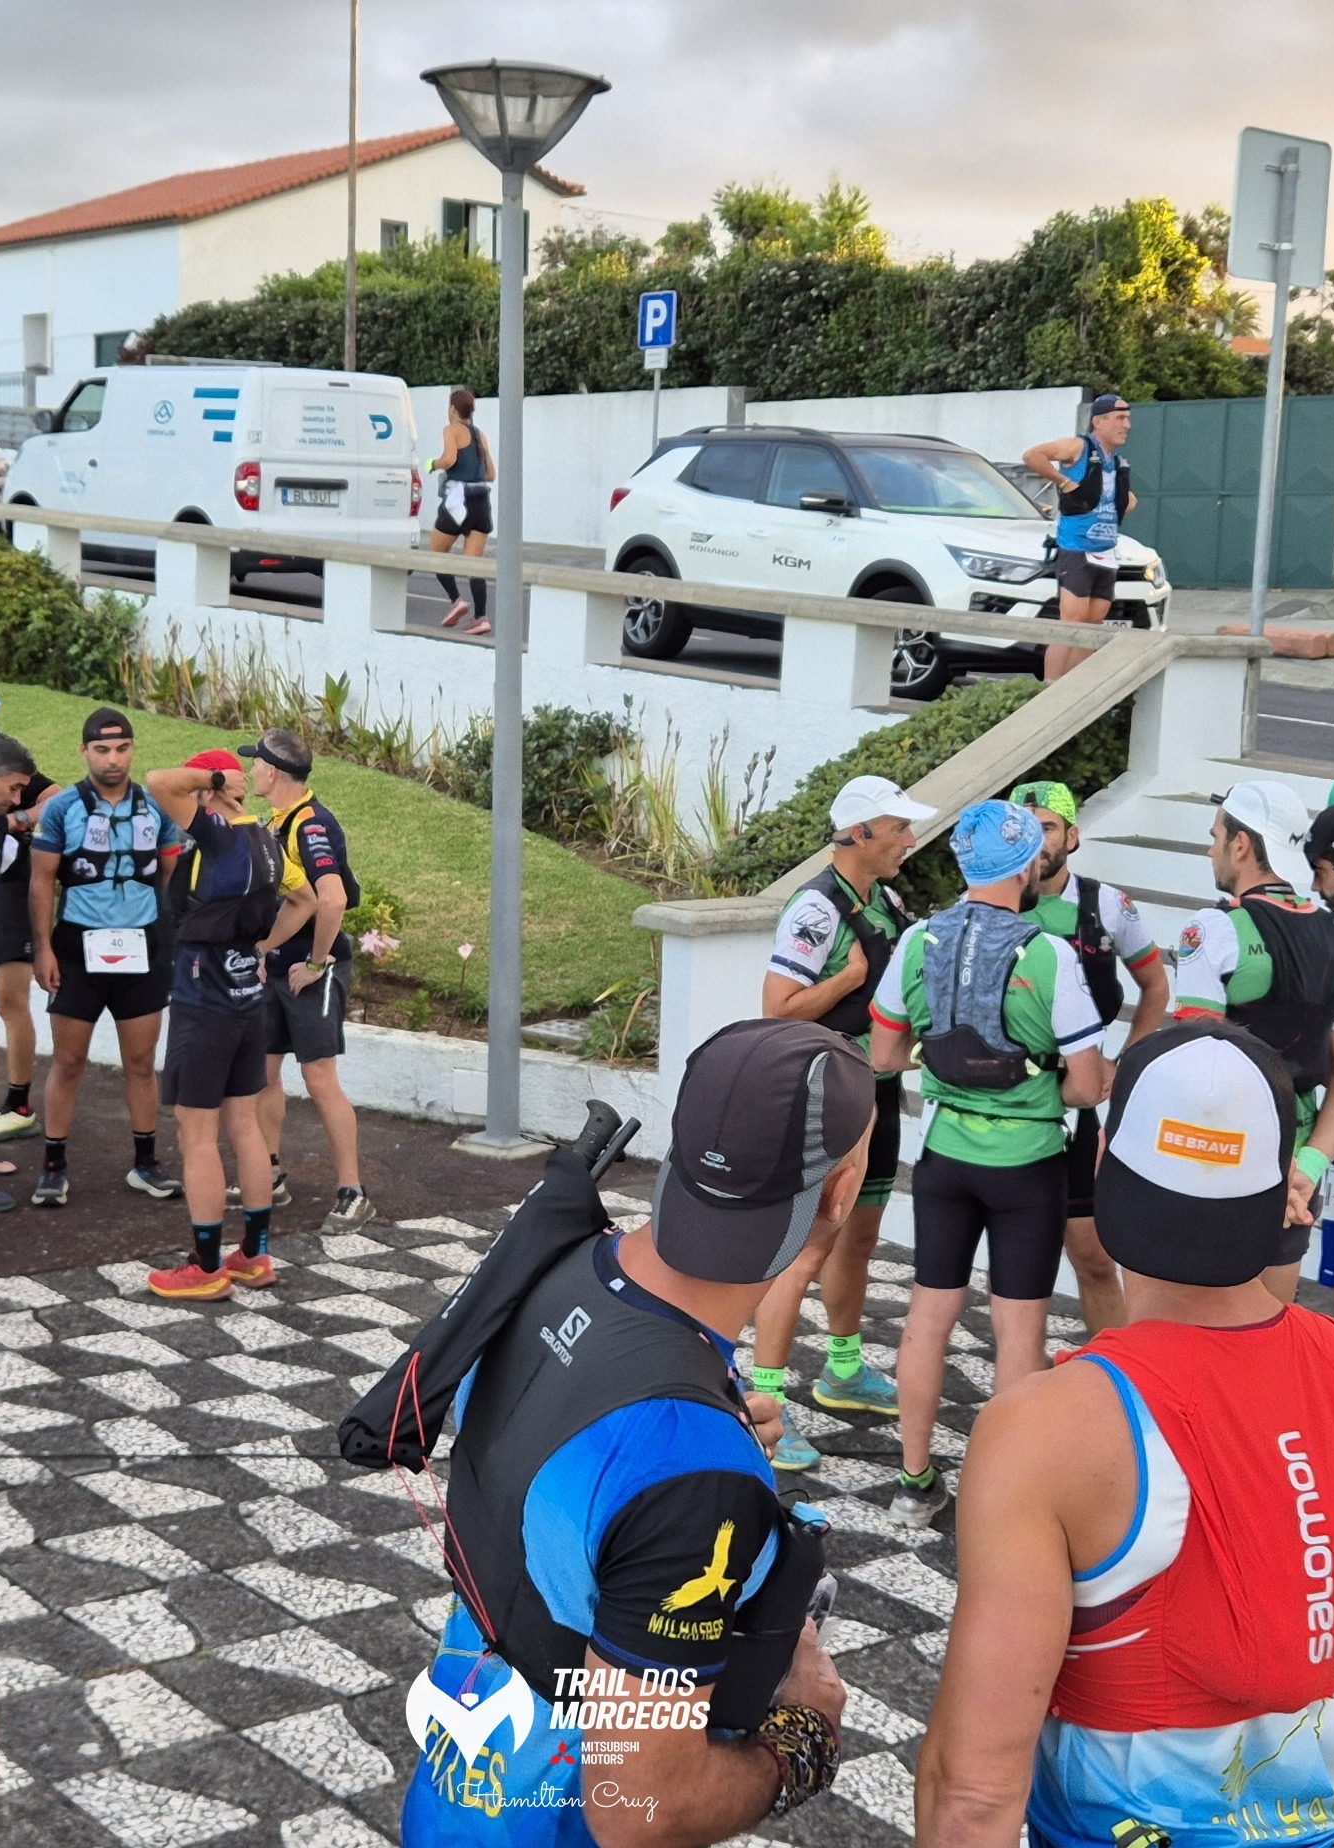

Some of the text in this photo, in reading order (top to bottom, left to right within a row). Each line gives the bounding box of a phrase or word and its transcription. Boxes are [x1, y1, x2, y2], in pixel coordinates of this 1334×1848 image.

[645, 299, 667, 342] P
[689, 544, 740, 558] KORANDO
[772, 554, 811, 571] KGM
[110, 938, 124, 948] 40
[1164, 1131, 1240, 1156] BE BRAVE
